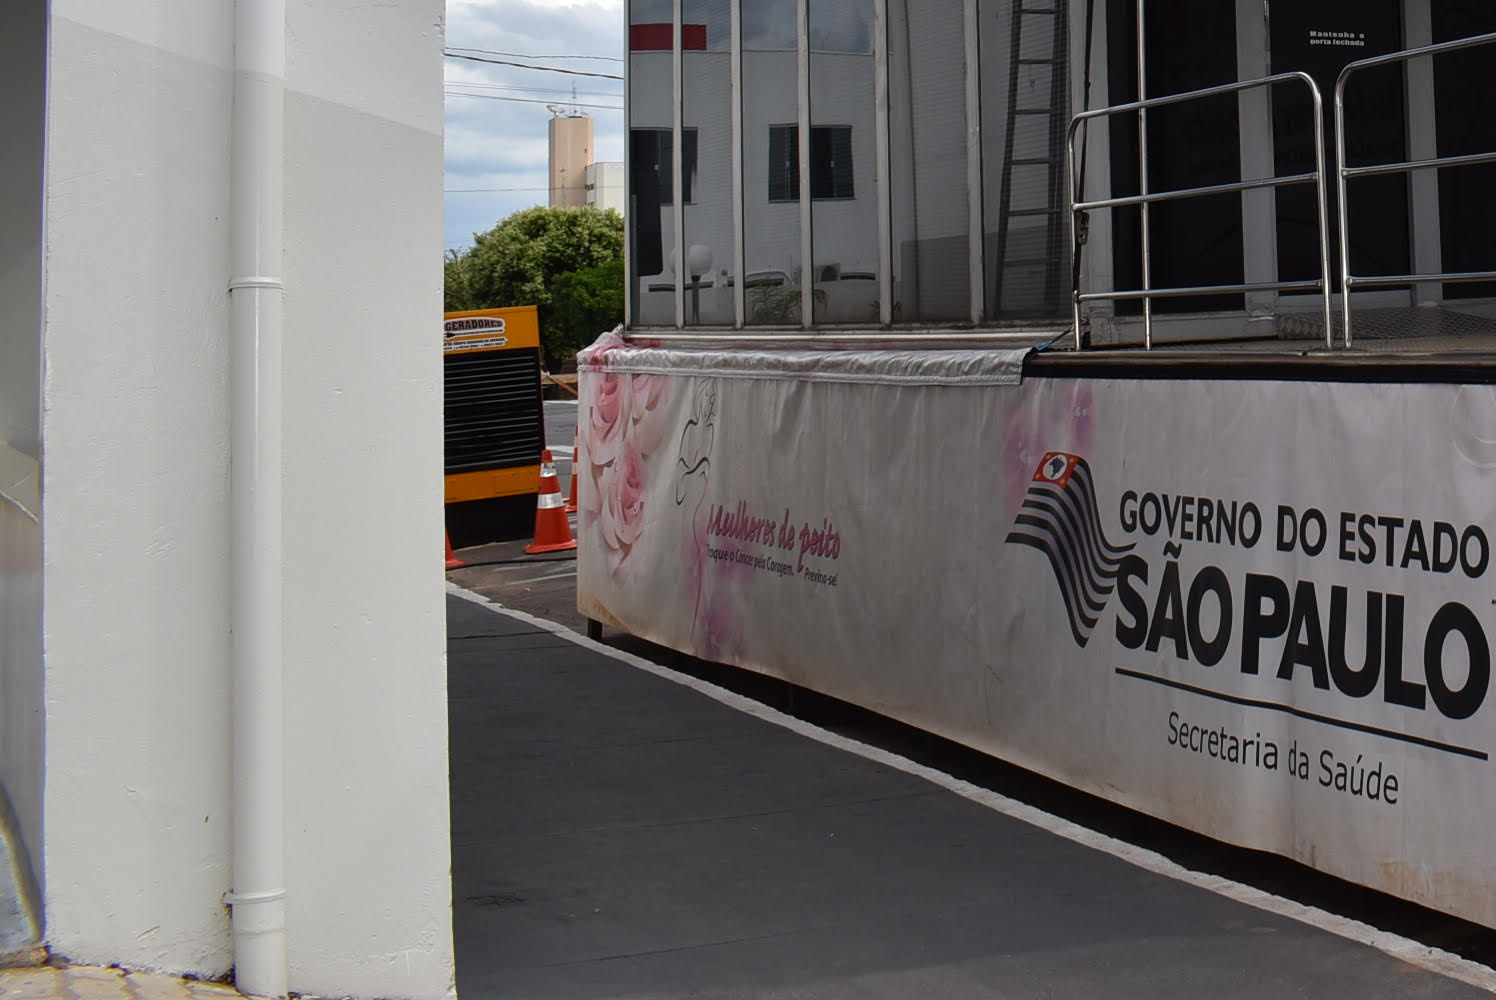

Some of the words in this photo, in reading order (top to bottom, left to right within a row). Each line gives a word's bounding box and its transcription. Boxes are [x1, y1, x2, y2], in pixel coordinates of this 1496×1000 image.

[1332, 38, 1365, 47] fechada
[445, 319, 503, 332] GERADORES
[706, 499, 777, 548] Mulheres
[778, 507, 796, 551] de
[798, 516, 841, 573] peito
[1119, 490, 1262, 549] GOVERNO
[1276, 505, 1328, 557] DO
[1338, 511, 1490, 579] ESTADO
[1115, 541, 1233, 667] SÃO
[1240, 572, 1491, 720] PAULO
[1167, 711, 1279, 771] Secretaria
[1288, 739, 1310, 781] da
[1318, 749, 1400, 805] Saúde
